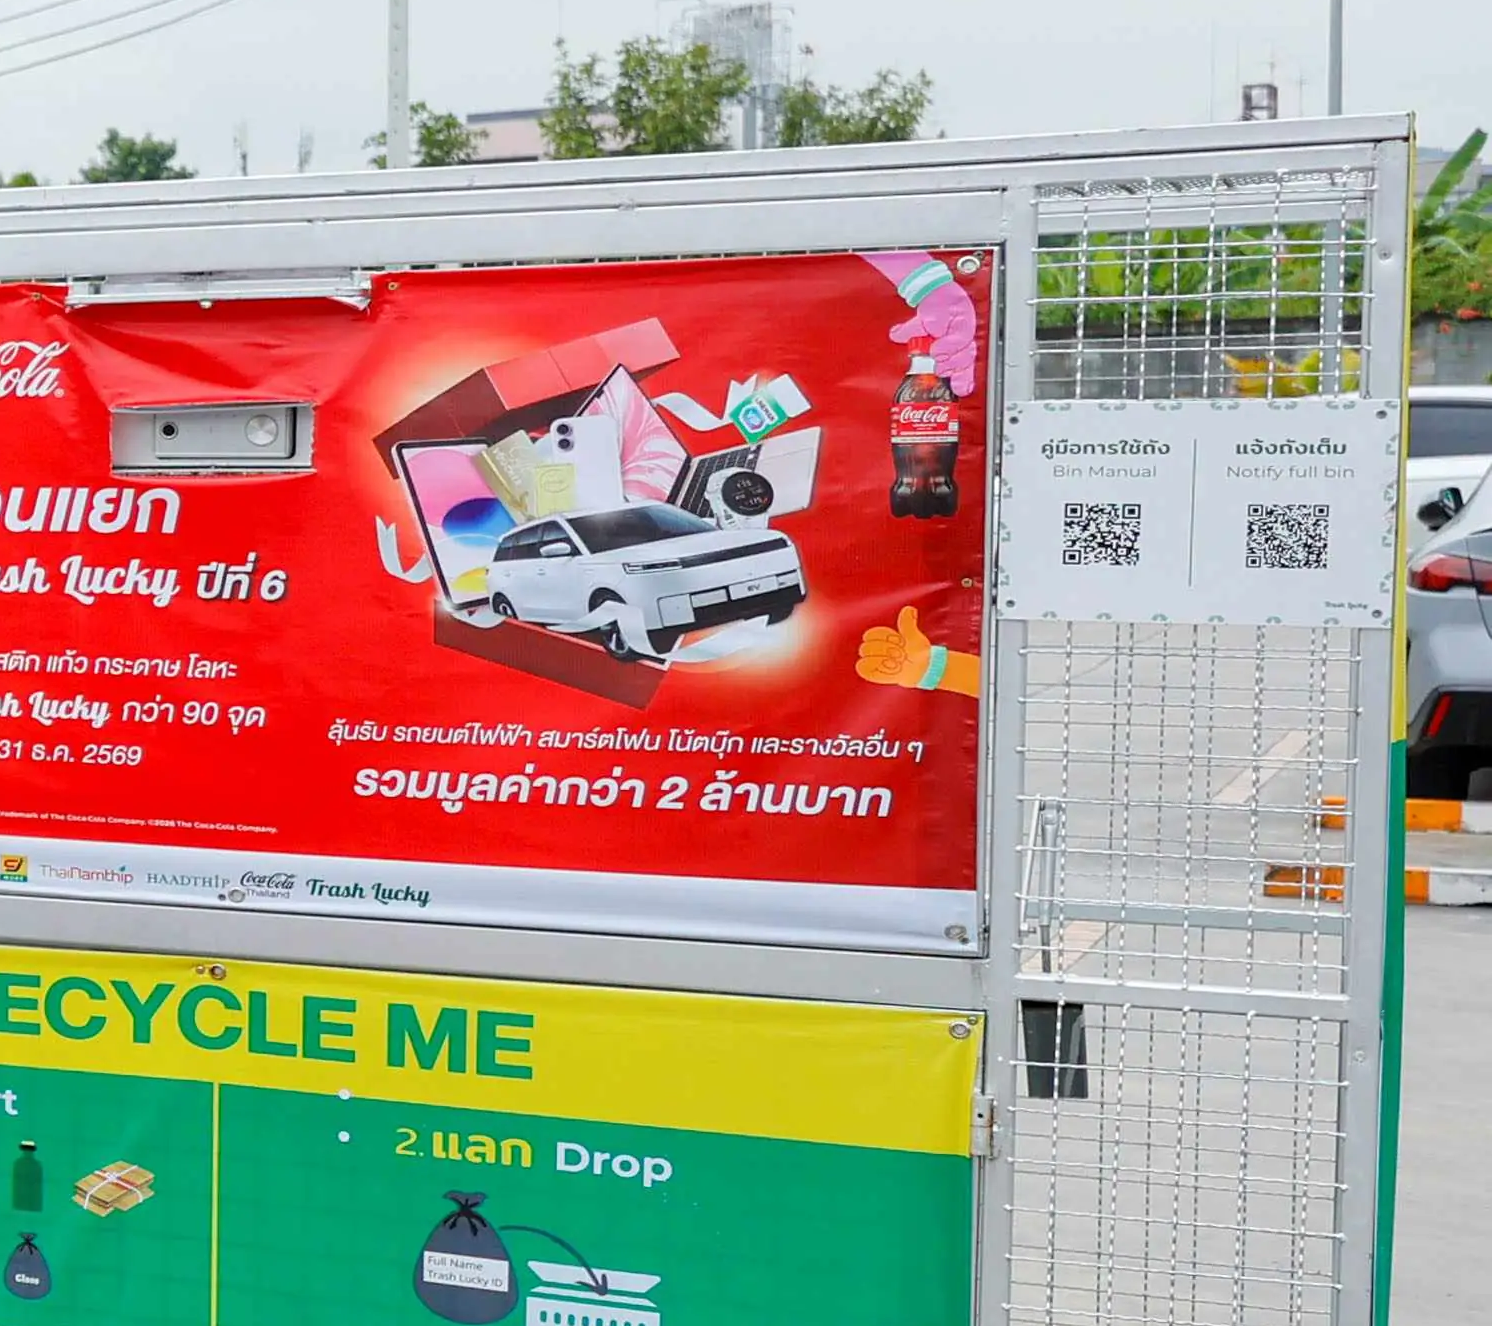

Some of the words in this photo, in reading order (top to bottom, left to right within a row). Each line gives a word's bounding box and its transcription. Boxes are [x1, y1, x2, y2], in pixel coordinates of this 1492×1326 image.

[1041, 437, 1171, 460] คู่มือการใช้ถัง
[1235, 438, 1347, 456] แจ้งถังเต็ม
[1053, 465, 1083, 478] Bin
[1088, 464, 1157, 479] Manual
[1227, 464, 1283, 481] Notify
[1288, 464, 1320, 479] full
[1324, 464, 1355, 479] bin
[62, 556, 181, 608] Lucky
[196, 551, 256, 602] ปีที่
[264, 569, 287, 601] 6
[46, 651, 88, 676] แก้ว
[94, 656, 180, 679] กระดาษ
[187, 655, 238, 680] โลหะ
[27, 691, 109, 728] Lucky
[121, 696, 175, 724] กว่า
[182, 701, 219, 726] 90
[227, 706, 266, 735] จุด
[327, 717, 387, 745] ลุ้นรับ
[392, 720, 532, 748] รถยนต์ไฟฟ้า
[750, 728, 899, 759] และรางวัลอื่น
[32, 741, 76, 763] ธ.ค.
[82, 744, 143, 766] 2569
[353, 763, 645, 814] รวมมูลค่ากว่า
[655, 776, 685, 809] 2
[699, 769, 892, 819] ล้านบาท
[240, 871, 297, 890] Coca-Cola
[305, 877, 364, 899] Trash
[370, 881, 431, 908] Lucky
[387, 1002, 535, 1080] ME
[556, 1141, 673, 1187] Drop
[427, 1256, 450, 1269] Full
[453, 1258, 484, 1272] Name
[15, 1273, 40, 1286] Glass
[427, 1270, 457, 1284] Trash
[459, 1272, 489, 1288] Lucky
[491, 1277, 503, 1288] ID
